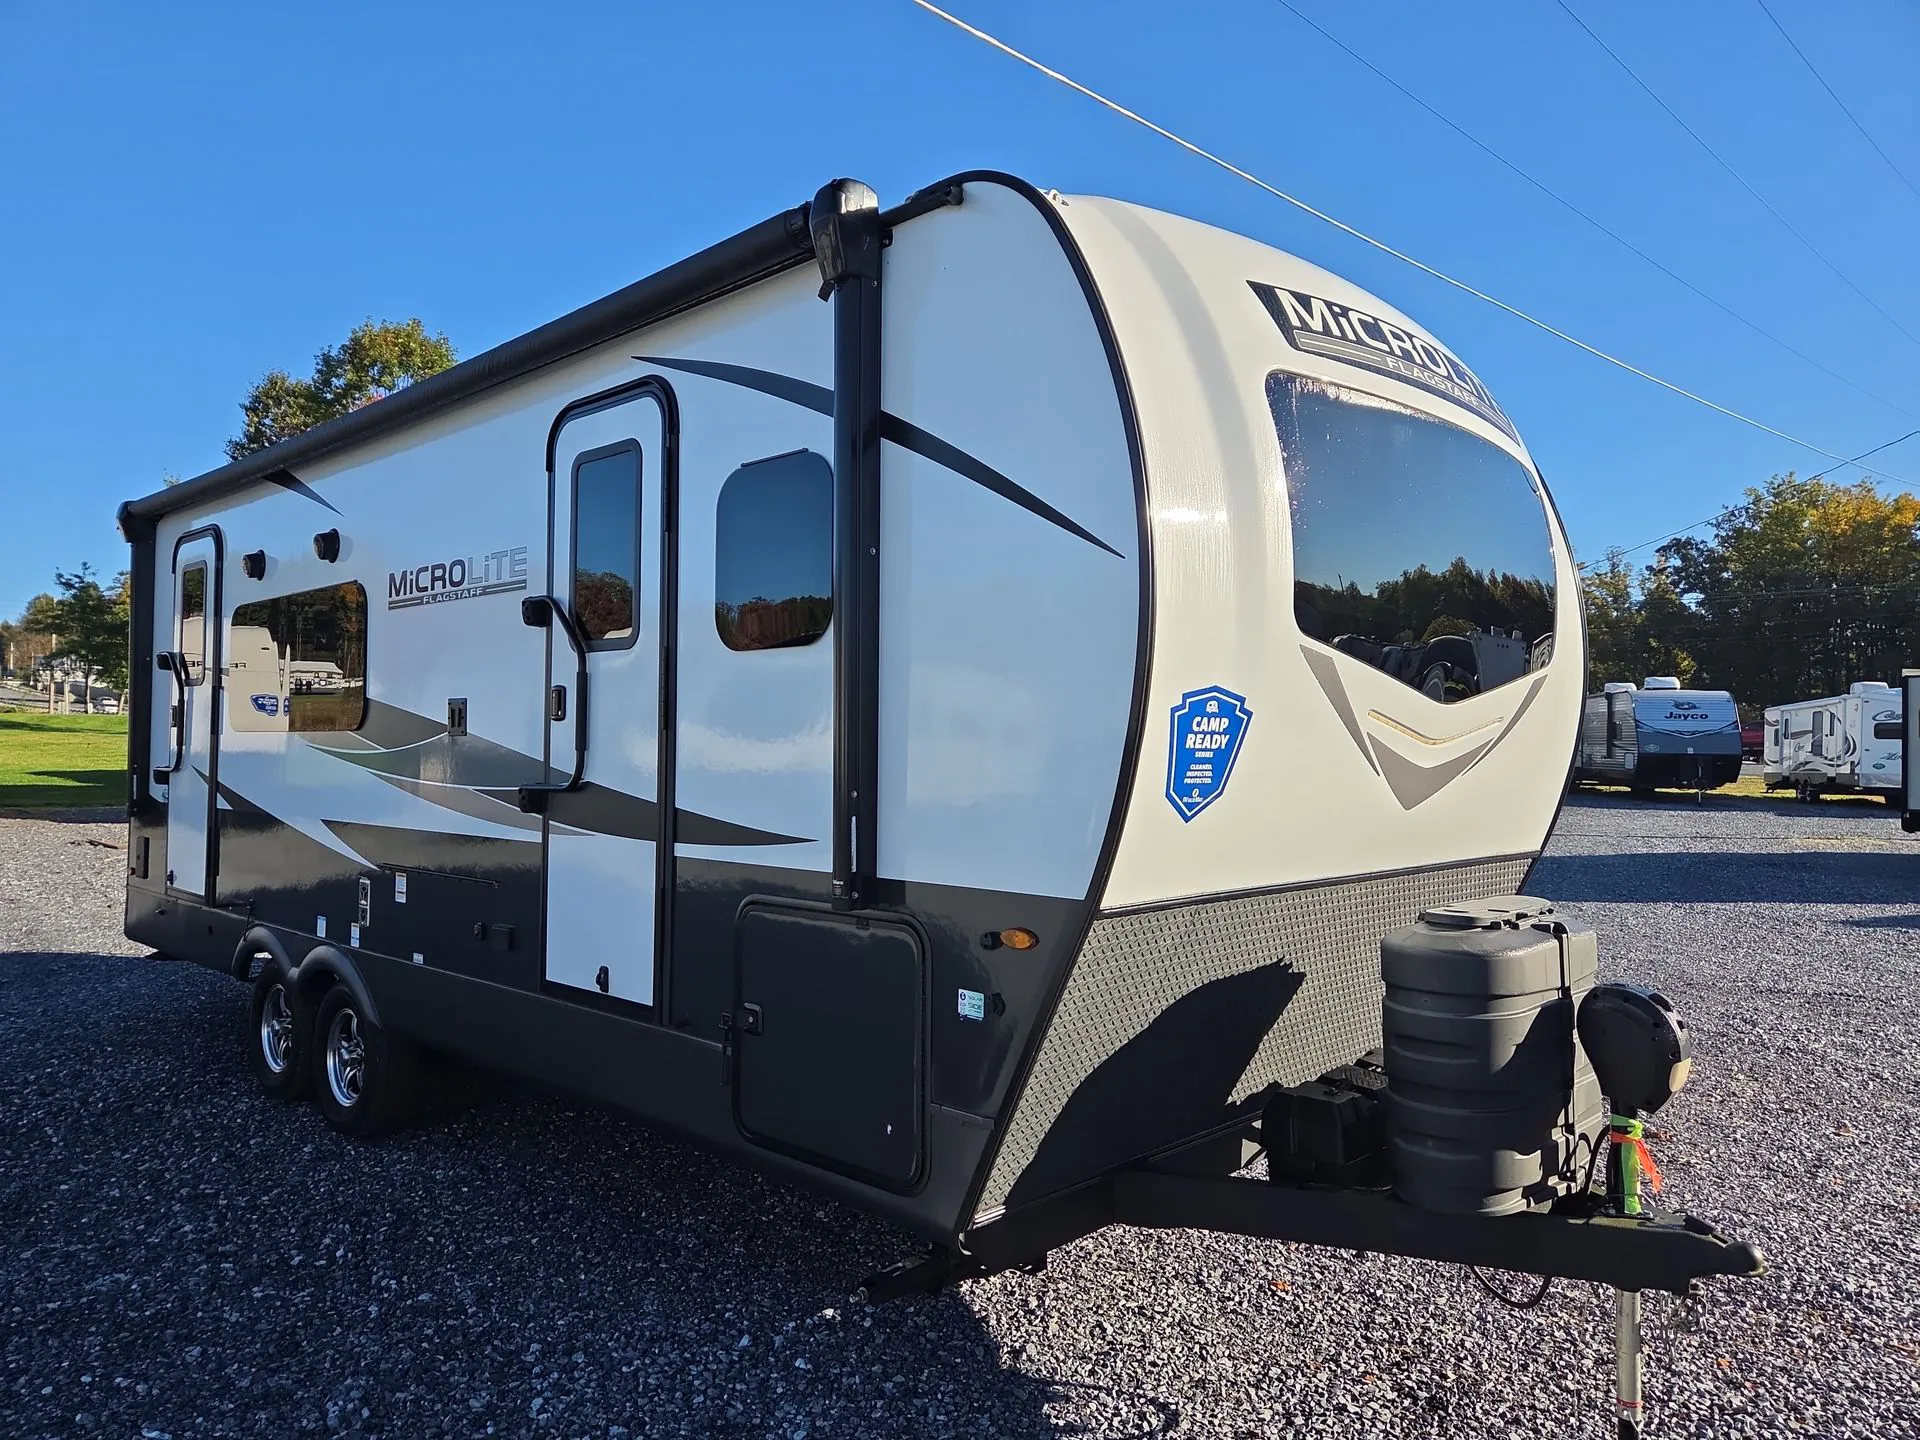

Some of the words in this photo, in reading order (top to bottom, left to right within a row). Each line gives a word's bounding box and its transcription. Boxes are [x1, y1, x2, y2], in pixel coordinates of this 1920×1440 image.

[1386, 355, 1480, 407] FLAGSTAFF
[423, 587, 484, 605] FLAGSTAFF
[1192, 716, 1229, 732] CAMP
[1664, 711, 1709, 721] Jayco
[1185, 734, 1230, 749] READY
